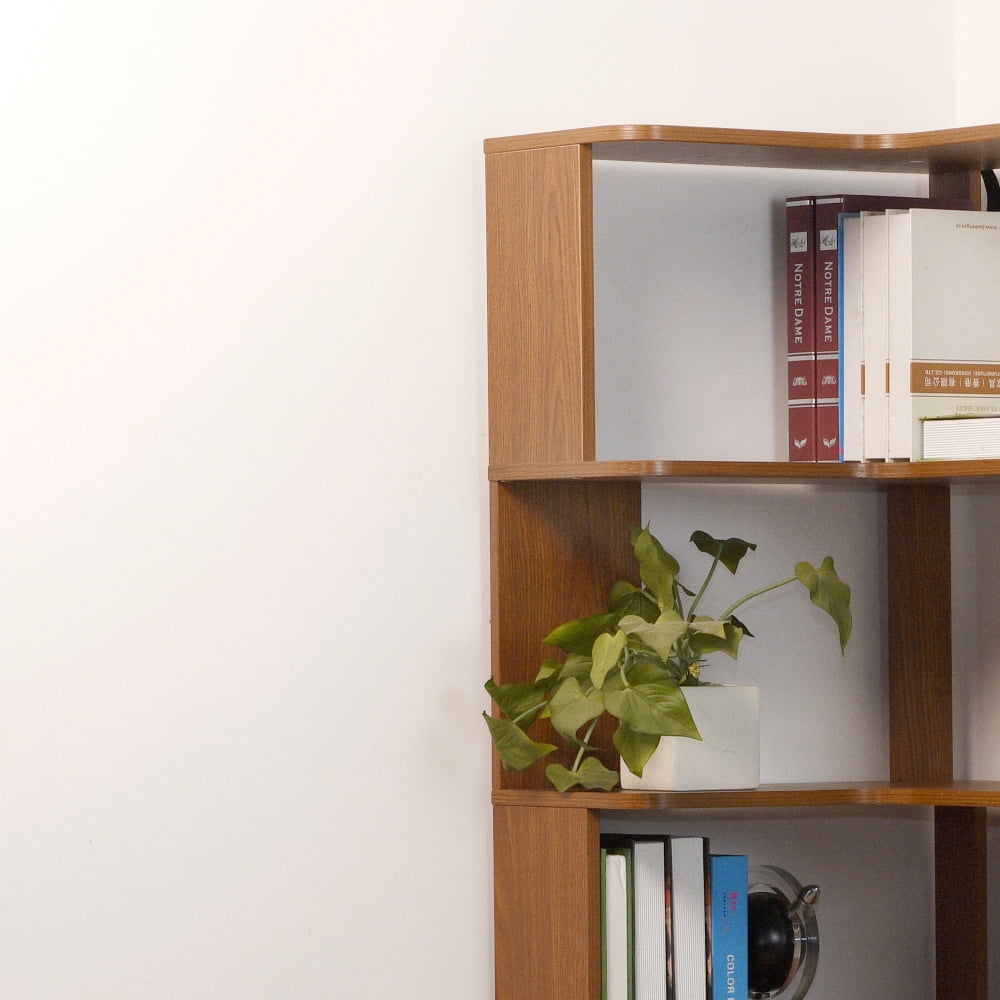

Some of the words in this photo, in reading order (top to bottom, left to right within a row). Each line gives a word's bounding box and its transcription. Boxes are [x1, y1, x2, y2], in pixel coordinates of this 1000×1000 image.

[794, 263, 804, 305] NOTRE
[824, 261, 834, 304] NOTRE
[794, 308, 804, 344] DAME
[823, 306, 834, 342] DAME
[726, 954, 735, 994] COLOR
